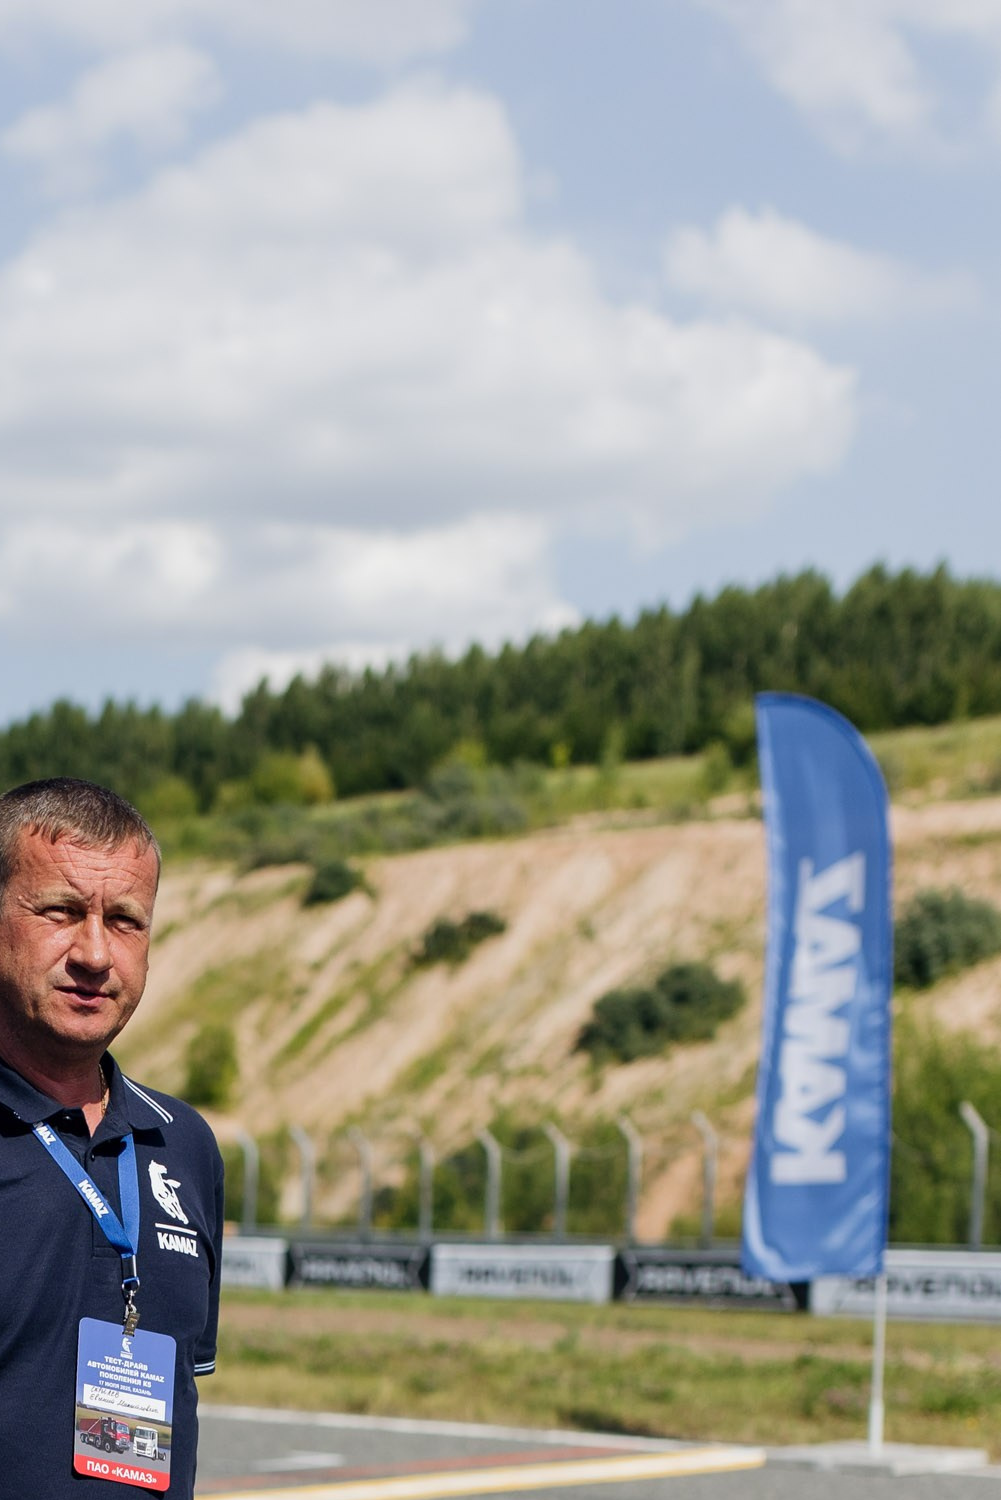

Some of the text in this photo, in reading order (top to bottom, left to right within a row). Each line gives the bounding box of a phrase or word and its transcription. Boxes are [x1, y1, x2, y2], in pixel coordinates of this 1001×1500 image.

[33, 1121, 57, 1146] MAZ
[77, 1178, 109, 1218] KAMAZ
[156, 1231, 199, 1258] KAMAZ
[87, 1360, 139, 1377] АВТОМОБИЛЕЙ
[104, 1356, 148, 1371] ТЕСТ-ДРАЙВ
[99, 1371, 141, 1386] ПОКОЛЕНИЯ
[132, 1387, 152, 1396] КАЗАНЬ
[86, 1461, 157, 1483] ПАО «КАМАЗ»
